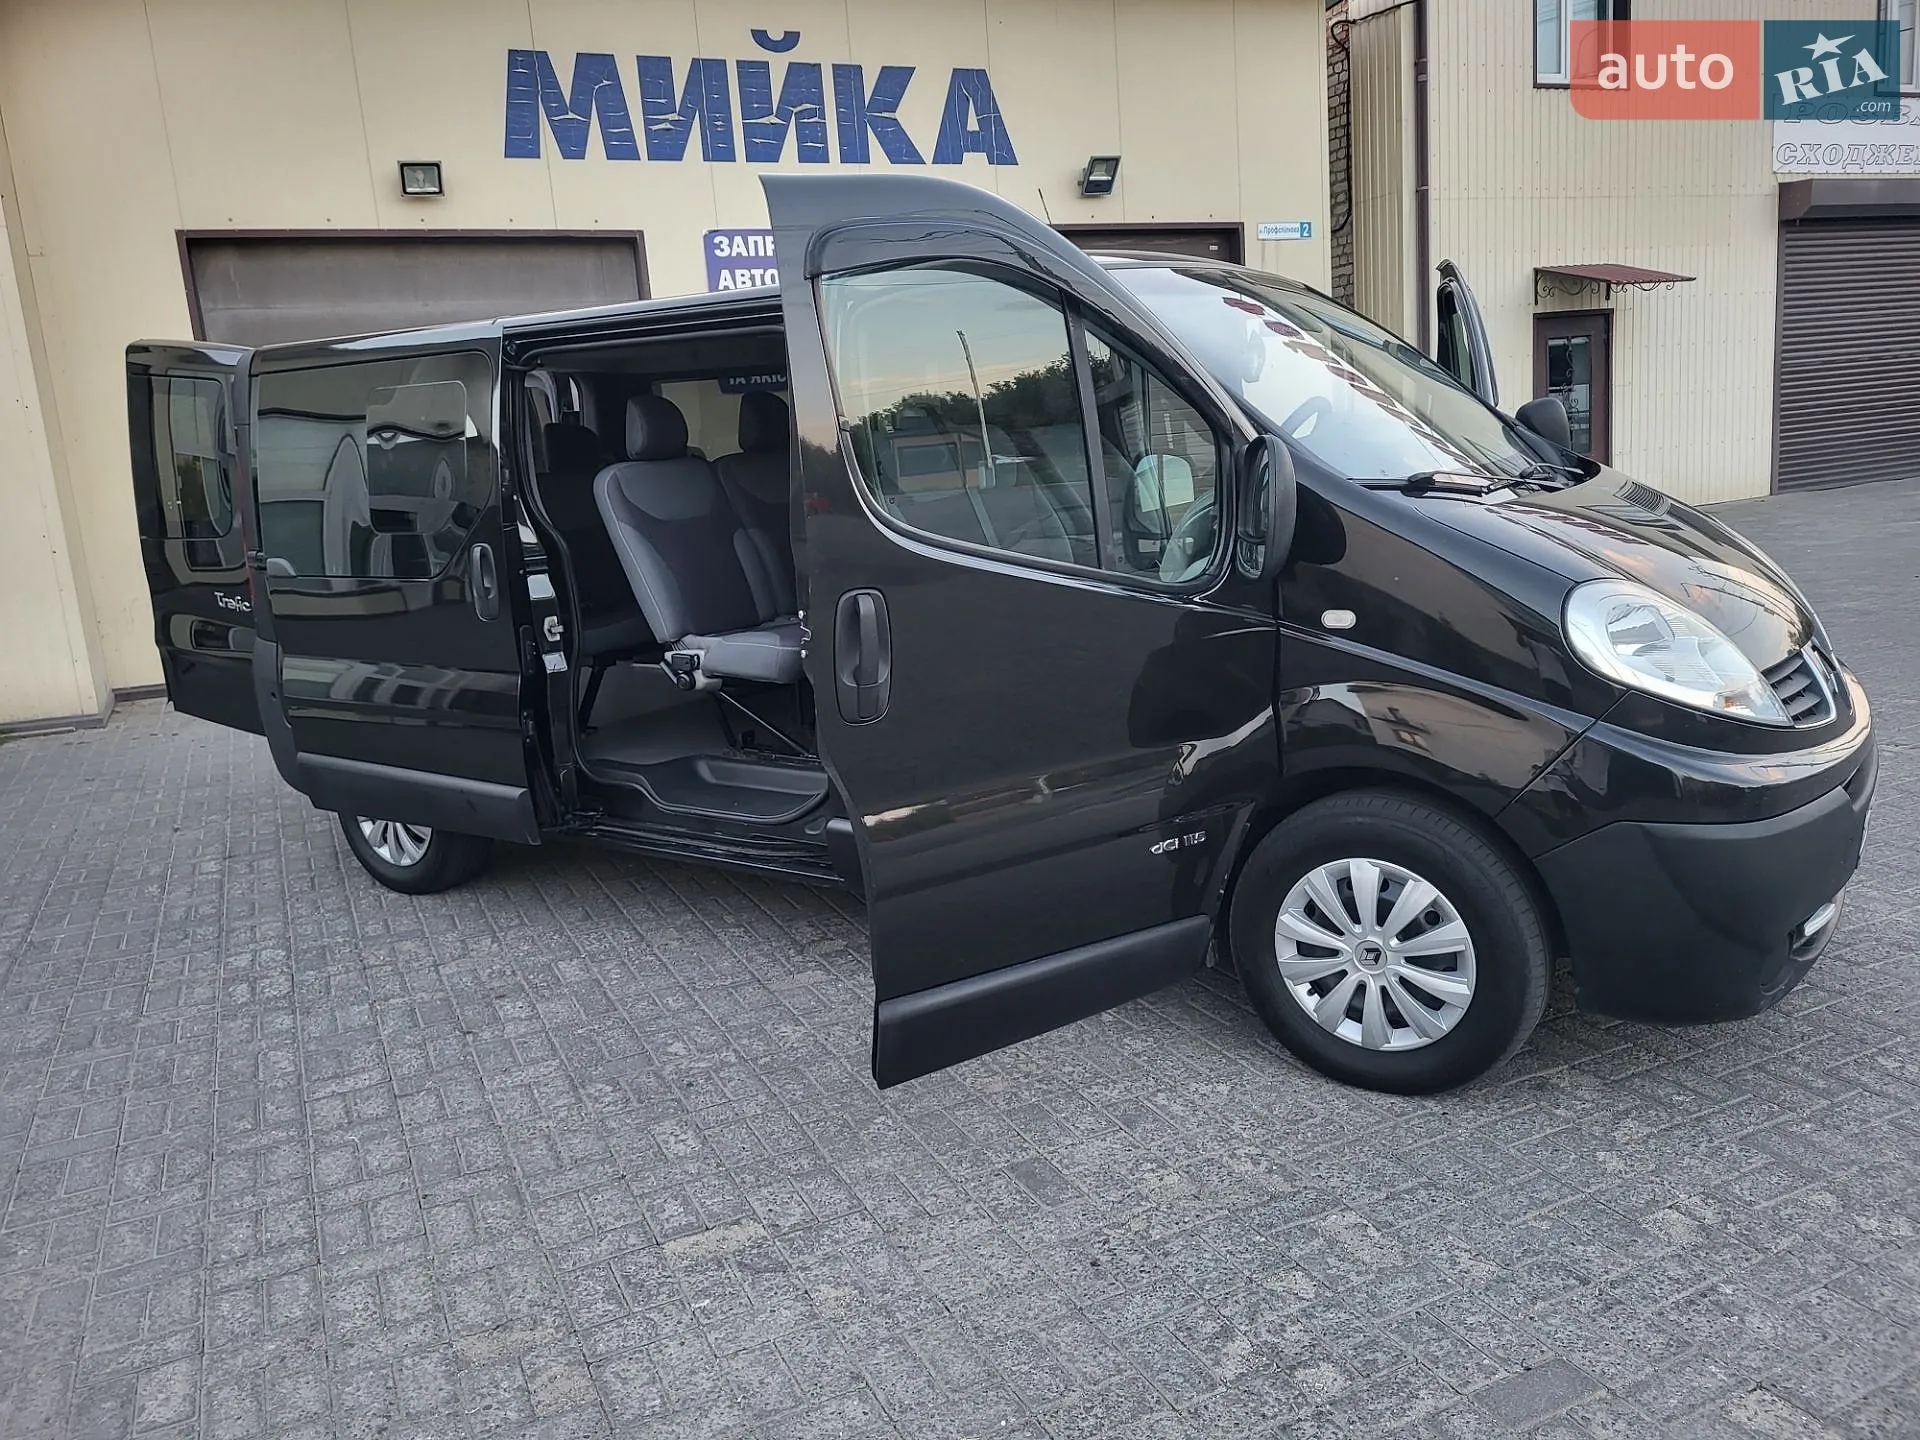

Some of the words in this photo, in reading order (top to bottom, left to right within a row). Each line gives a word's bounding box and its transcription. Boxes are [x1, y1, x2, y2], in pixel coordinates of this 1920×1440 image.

[504, 29, 1019, 166] МИЙКА
[1302, 223, 1310, 237] 2
[214, 591, 252, 612] Trafic
